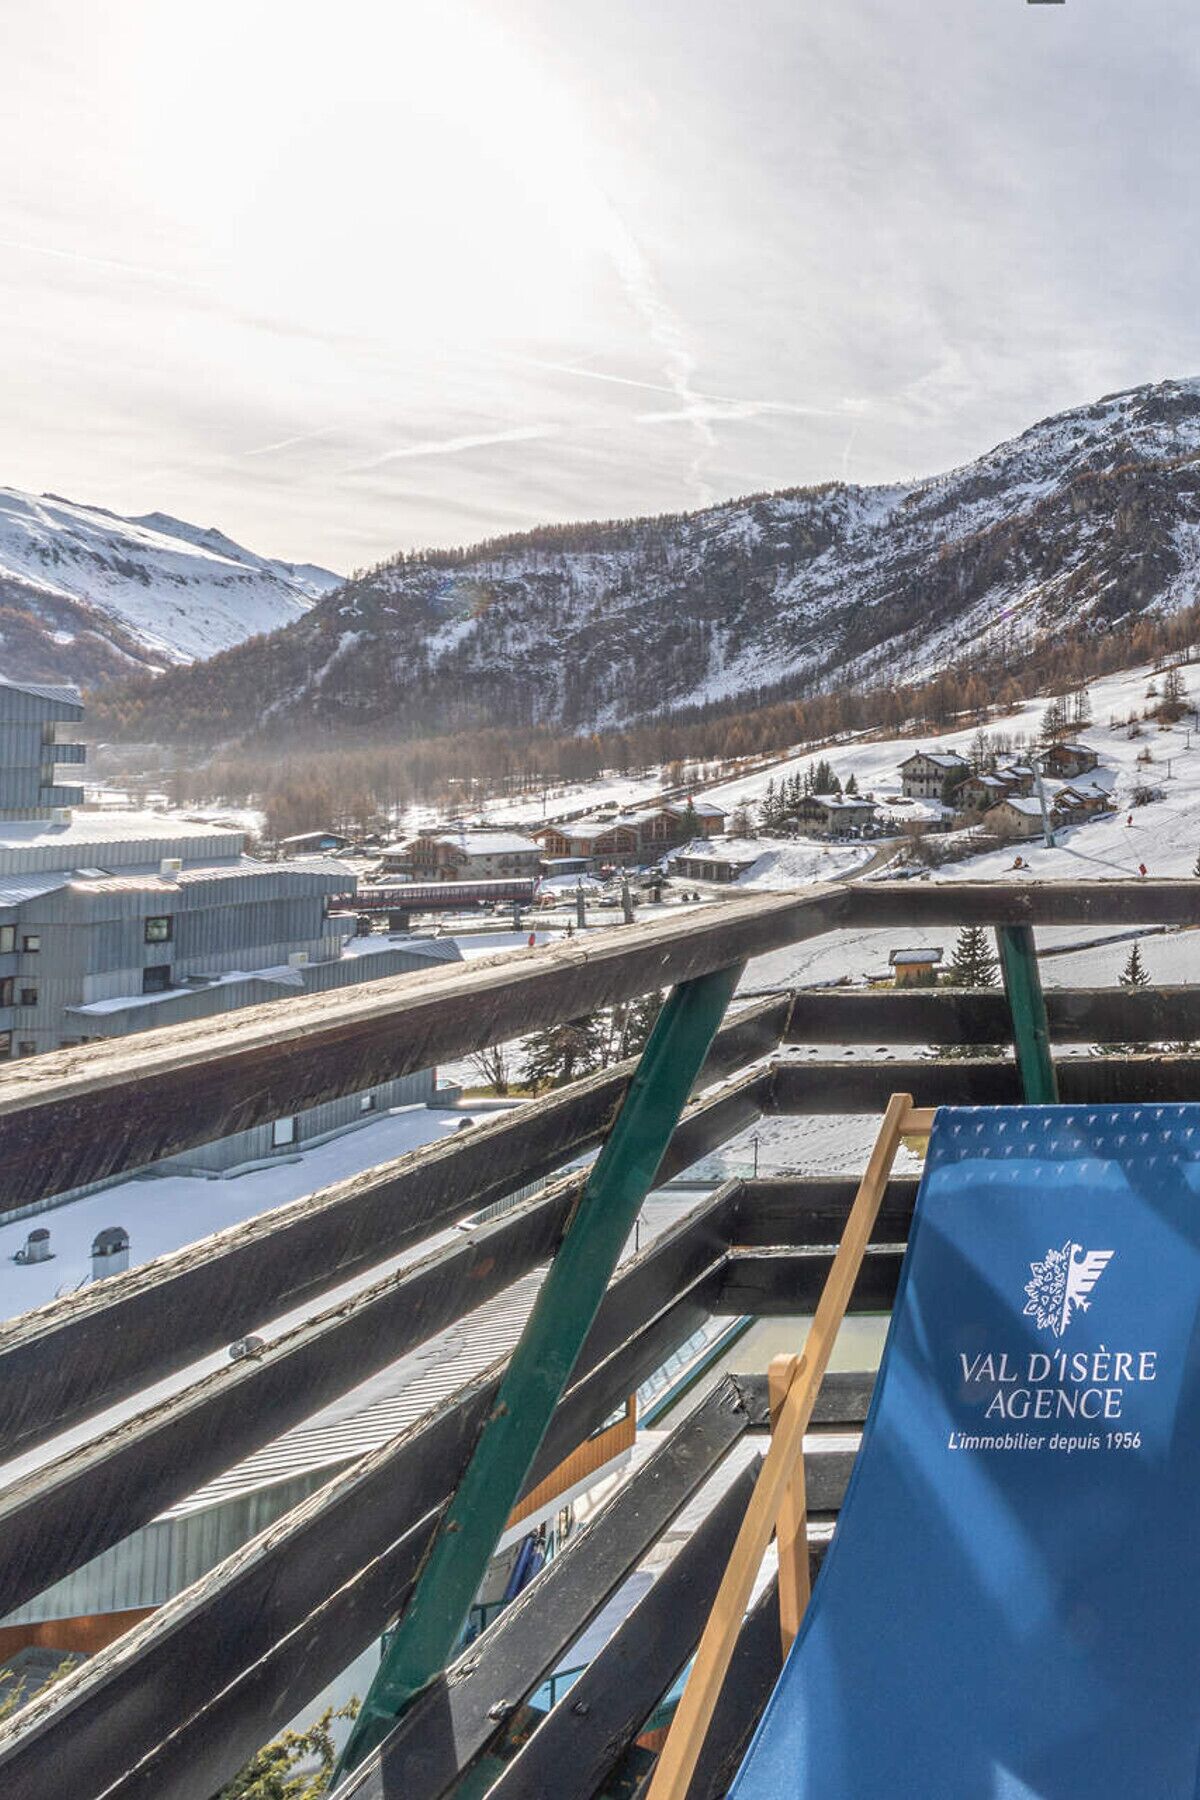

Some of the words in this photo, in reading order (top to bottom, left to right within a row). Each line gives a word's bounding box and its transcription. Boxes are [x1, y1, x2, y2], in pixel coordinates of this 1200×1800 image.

[959, 1352, 1018, 1382] VAL
[1027, 1344, 1158, 1382] D'ISÈRE
[984, 1388, 1123, 1419] AGENCE
[947, 1432, 1046, 1450] L'immobilier
[1049, 1433, 1100, 1453] depuis
[1106, 1432, 1142, 1449] 1956
